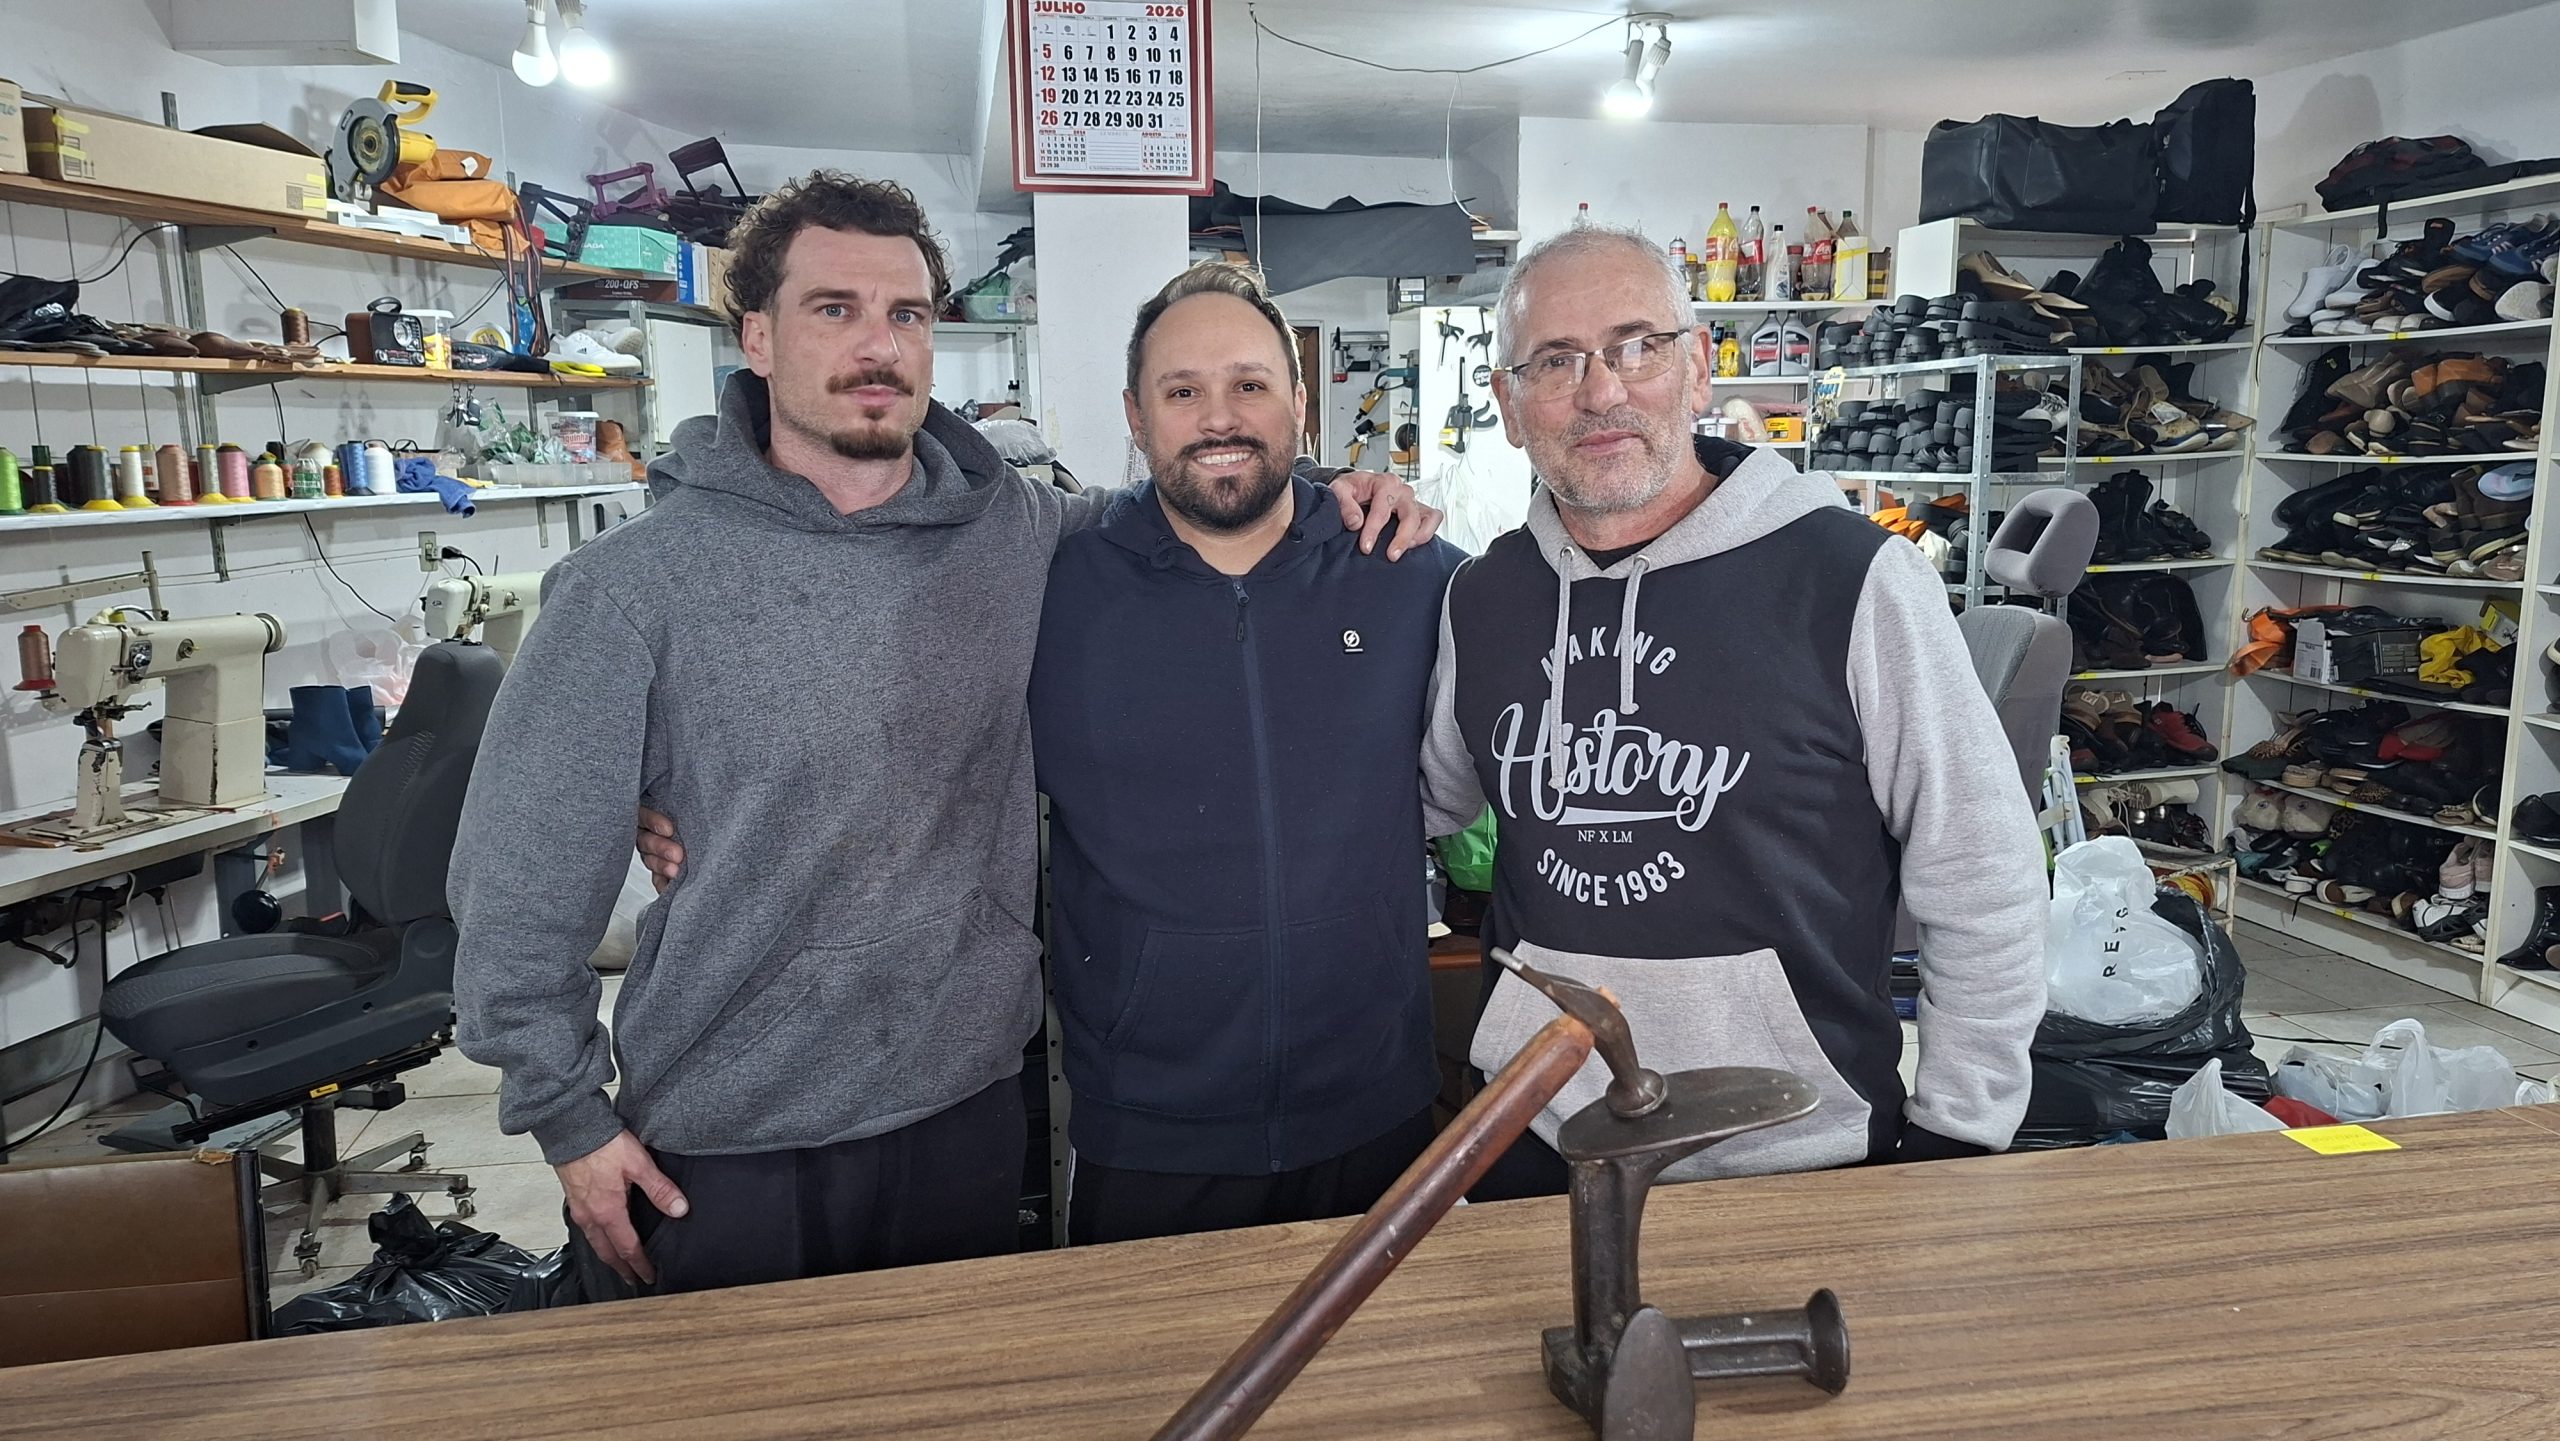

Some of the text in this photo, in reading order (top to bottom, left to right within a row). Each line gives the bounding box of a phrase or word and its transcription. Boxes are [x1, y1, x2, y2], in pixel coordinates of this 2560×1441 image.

[1034, 1, 1185, 17] JULHO 2026
[1107, 24, 1179, 42] 1 2 3 4
[1042, 43, 1181, 63] 5 6 7 8 9 10 11
[1039, 65, 1183, 86] 12 13 14 15 16 17 18
[1040, 87, 1185, 108] 19 20 21 22 23 24 25
[1040, 109, 1163, 129] 26 27 28 29 30 31
[1491, 699, 1751, 832] History
[1577, 830, 1633, 844] NF X LM
[1537, 848, 1686, 907] SINCE 1983
